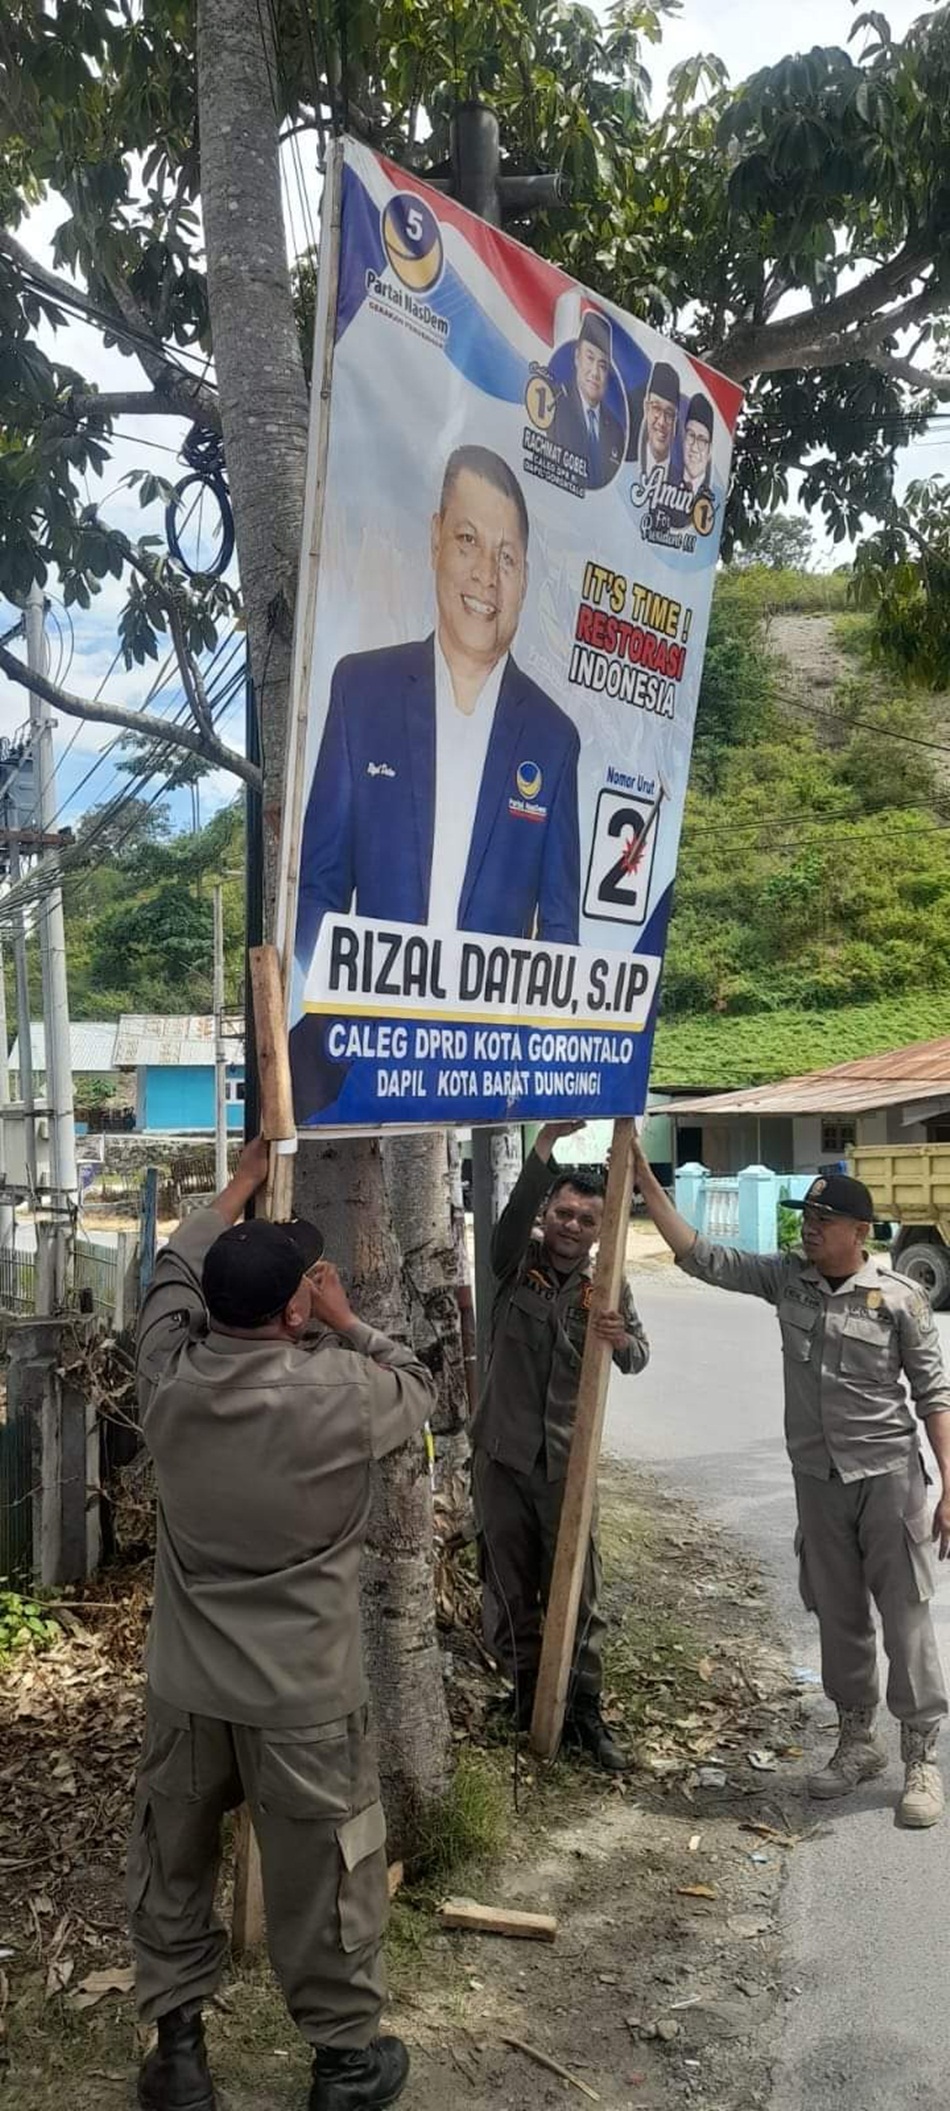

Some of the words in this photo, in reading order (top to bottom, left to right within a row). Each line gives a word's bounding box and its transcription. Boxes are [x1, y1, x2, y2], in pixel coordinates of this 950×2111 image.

[405, 208, 423, 241] 5
[367, 271, 403, 307] Partai
[404, 293, 449, 335] NasDem
[535, 387, 547, 419] 1
[523, 427, 562, 464] RACHMAT
[562, 449, 588, 478] GOBEL
[631, 466, 694, 514] Amin
[582, 562, 627, 613] IT'S
[631, 583, 681, 639] TIME
[682, 609, 693, 643] !
[575, 603, 686, 682] RESTORASI
[569, 645, 677, 719] INDONESIA
[606, 765, 635, 789] Nomor
[637, 774, 655, 795] Urut
[598, 808, 645, 906] 2
[329, 926, 446, 999] RIZAL
[459, 943, 577, 1014] DATAU,
[587, 959, 649, 1012] S.IP
[329, 1024, 407, 1058] CALEG
[415, 1029, 466, 1060] DPRD
[474, 1032, 523, 1061] KOTA
[528, 1035, 634, 1064] GORONTALO
[377, 1070, 427, 1098] DAPIL
[437, 1072, 476, 1097] KOTA
[483, 1072, 529, 1097] BARAT
[534, 1072, 601, 1096] DUNGINGI
